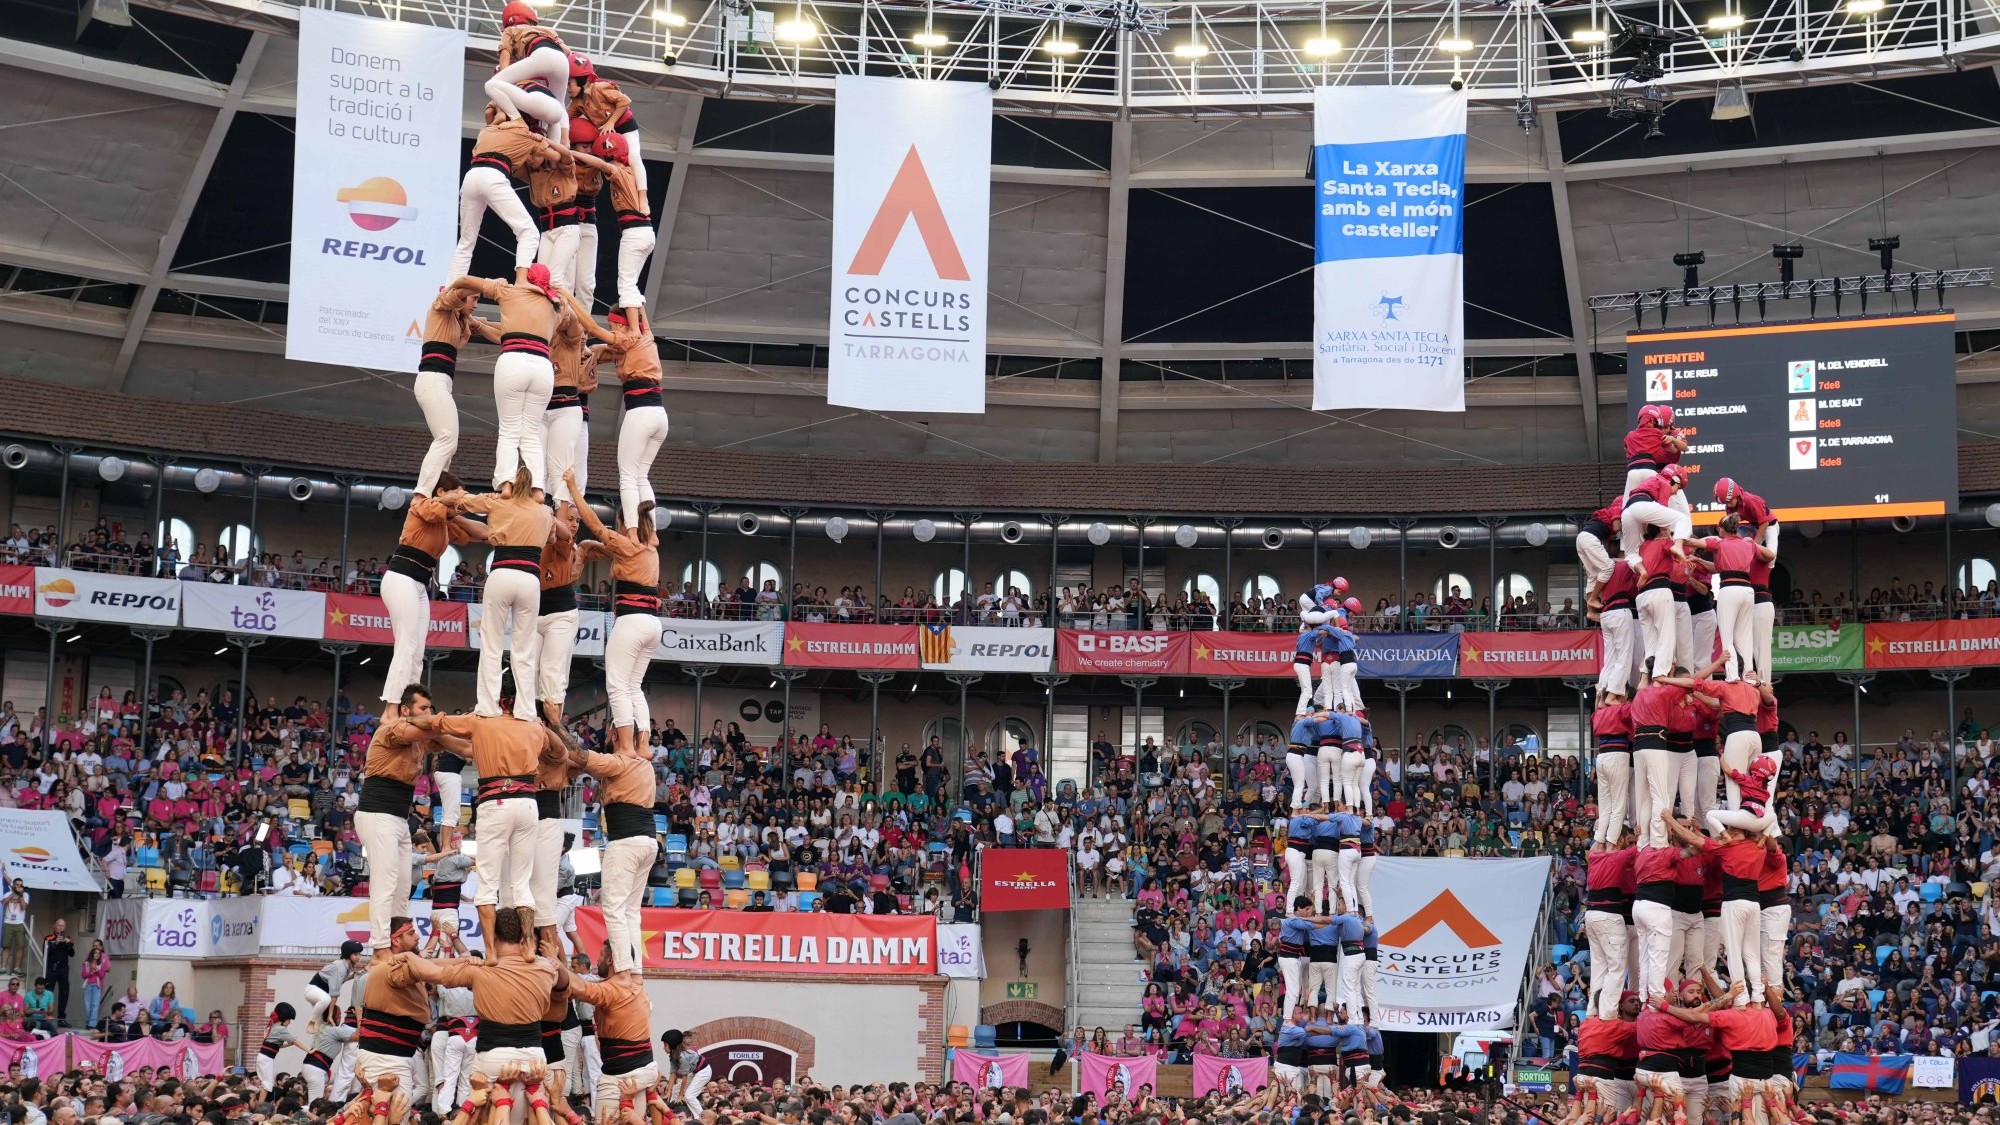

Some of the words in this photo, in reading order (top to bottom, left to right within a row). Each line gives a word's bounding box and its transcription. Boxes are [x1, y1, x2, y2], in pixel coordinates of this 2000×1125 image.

[331, 47, 400, 72] Donem
[330, 74, 393, 96] suport
[400, 84, 410, 98] a
[417, 82, 433, 101] la
[329, 95, 401, 121] tradició
[408, 105, 412, 122] i
[328, 118, 345, 137] la
[352, 124, 420, 147] cultura
[1343, 160, 1369, 176] La
[1374, 161, 1439, 176] Xarxa
[1323, 180, 1387, 196] Santa
[1393, 180, 1457, 198] Tecla,
[1321, 201, 1371, 216] amb
[1376, 201, 1397, 217] el
[1403, 200, 1453, 217] món
[1342, 222, 1439, 238] casteller
[321, 238, 426, 266] REPSOL
[845, 287, 970, 310] CONCURS
[319, 306, 370, 319] Patrocinador
[318, 317, 331, 325] del
[844, 309, 970, 332] CASTELLS
[318, 325, 350, 337] Concurs
[352, 330, 362, 338] de
[363, 331, 395, 342] Castells
[1327, 330, 1368, 342] XARXA
[1371, 330, 1410, 342] SANTA
[1413, 331, 1449, 344] TECLA
[844, 343, 969, 363] TARRAGONA
[1319, 342, 1370, 354] Sanitària,
[1373, 341, 1407, 352] Social
[1419, 343, 1457, 356] Docent
[1340, 356, 1383, 365] Tarragona
[1386, 356, 1401, 364] des
[1417, 355, 1443, 367] 1171
[1644, 351, 1705, 365] INTENTEN
[1827, 361, 1844, 370] DEL
[1844, 358, 1888, 370] VENDRELL
[1684, 370, 1696, 379] DE
[1696, 368, 1718, 378] REUS
[1818, 380, 1841, 390] 7de8
[1675, 389, 1697, 399] 5de8
[1675, 407, 1684, 416] C.
[1685, 406, 1697, 416] DE
[1697, 404, 1747, 416] BARCELONA
[1829, 399, 1841, 408] DE
[1841, 397, 1863, 407] SALT
[1819, 418, 1841, 428] 5de8
[1828, 437, 1841, 447] DE
[1841, 434, 1893, 446] TARRAGONA
[1697, 443, 1724, 454] SANTS
[1819, 457, 1842, 467] 5de8
[1874, 494, 1889, 503] 1/1
[90, 590, 177, 611] REPSOL
[230, 605, 277, 631] tac
[349, 613, 392, 629] ESTRE
[428, 620, 463, 632] AMM
[660, 630, 767, 652] CaixaBank
[1110, 635, 1168, 653] BASF
[1778, 629, 1840, 649] BASF
[1889, 639, 1957, 654] ESTRELLA
[807, 640, 871, 654] ESTRELLA
[874, 642, 916, 655] DAMM
[971, 643, 1050, 658] REPSOL
[1483, 649, 1548, 662] ESTRELLA
[1551, 648, 1594, 661] DAMM
[1078, 657, 1093, 667] We
[1095, 658, 1123, 667] create
[1125, 657, 1168, 669] chemistry
[1214, 650, 1278, 662] ESTRELLA
[1280, 650, 1322, 663] DAM
[1354, 648, 1452, 664] VANGUARDIA
[1795, 654, 1841, 665] chemistry
[10, 861, 71, 873] REPSOL
[154, 923, 197, 947] tac
[663, 930, 819, 964] ESTRELLA
[827, 936, 929, 965] DAMM
[939, 948, 972, 965] tac
[1376, 975, 1499, 990] ARRAGONA
[1417, 1011, 1501, 1026] SANITARIS
[1519, 1072, 1550, 1082] SORTIDA
